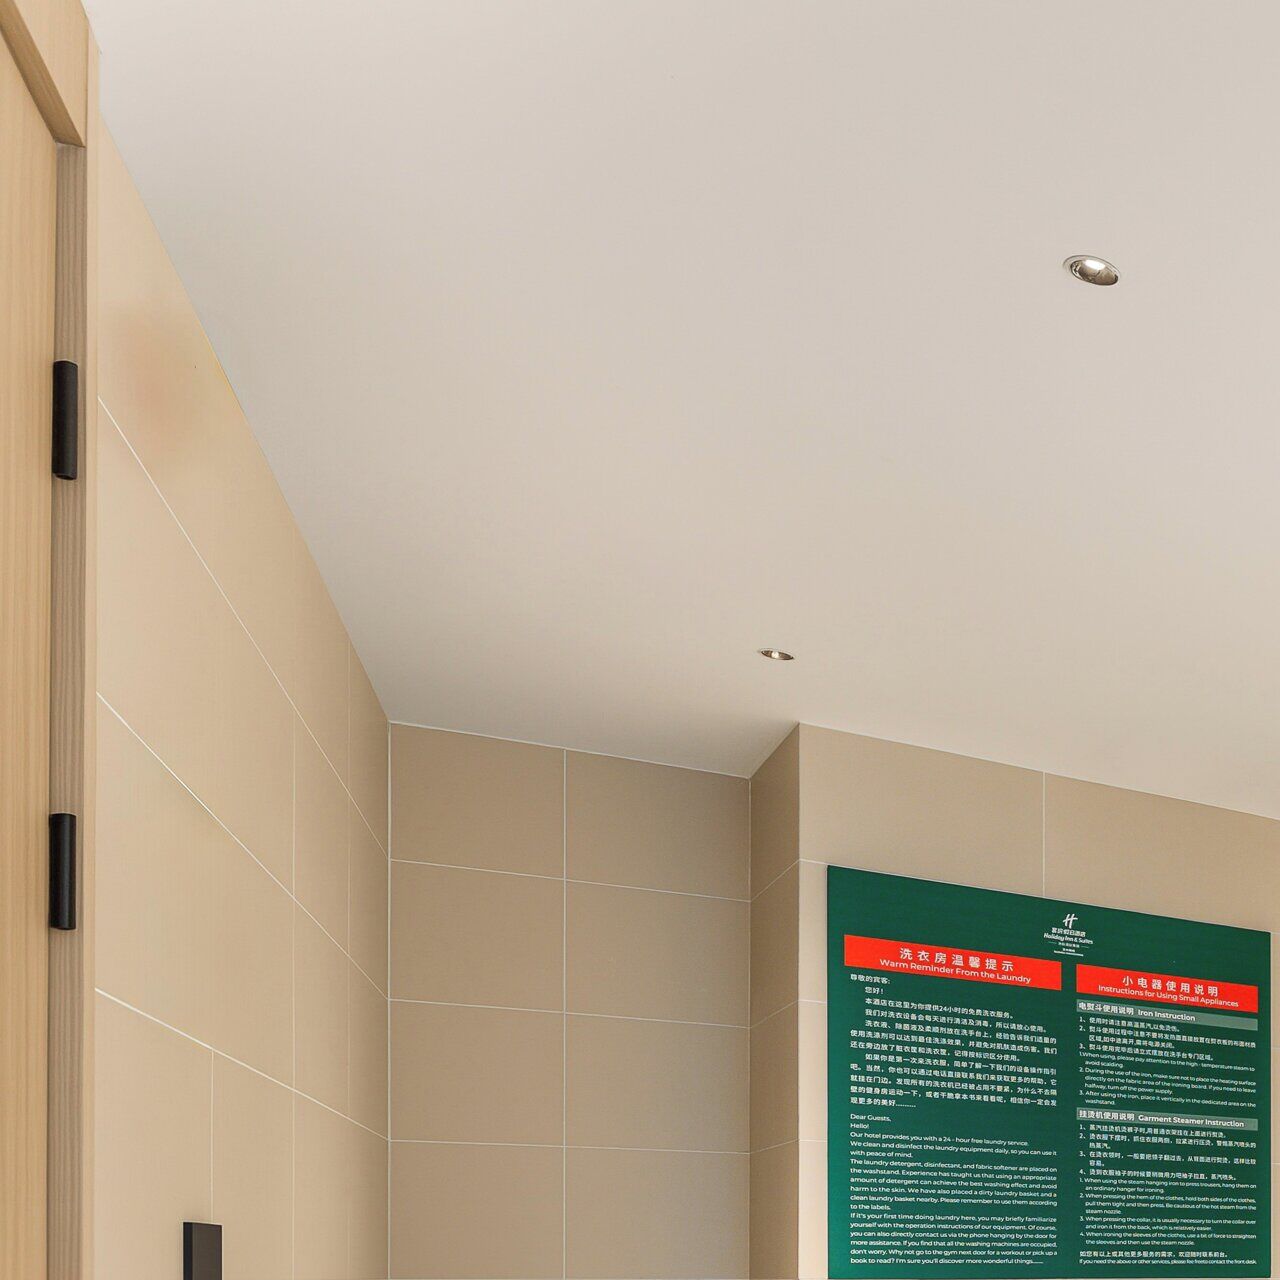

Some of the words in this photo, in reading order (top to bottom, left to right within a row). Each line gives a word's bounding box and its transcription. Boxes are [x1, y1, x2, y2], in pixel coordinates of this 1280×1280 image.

[1043, 932, 1065, 942] Holiday
[880, 959, 908, 968] Warm
[910, 962, 954, 974] Reminder
[955, 968, 979, 977] From
[980, 971, 996, 979] the
[997, 973, 1031, 984] Laundry
[899, 947, 1014, 973] 洗衣房温馨提示
[1099, 985, 1144, 996] Instructions
[1156, 992, 1178, 1001] Using
[1179, 994, 1199, 1002] Small
[1200, 997, 1239, 1008] Appliances
[1122, 975, 1219, 998] 小电器使用说明
[1138, 1009, 1154, 1017] Iron
[1154, 1011, 1195, 1021] Instruction
[1138, 1115, 1172, 1123] Garment
[1173, 1117, 1204, 1125] Steamer
[1205, 1119, 1244, 1127] Instruction
